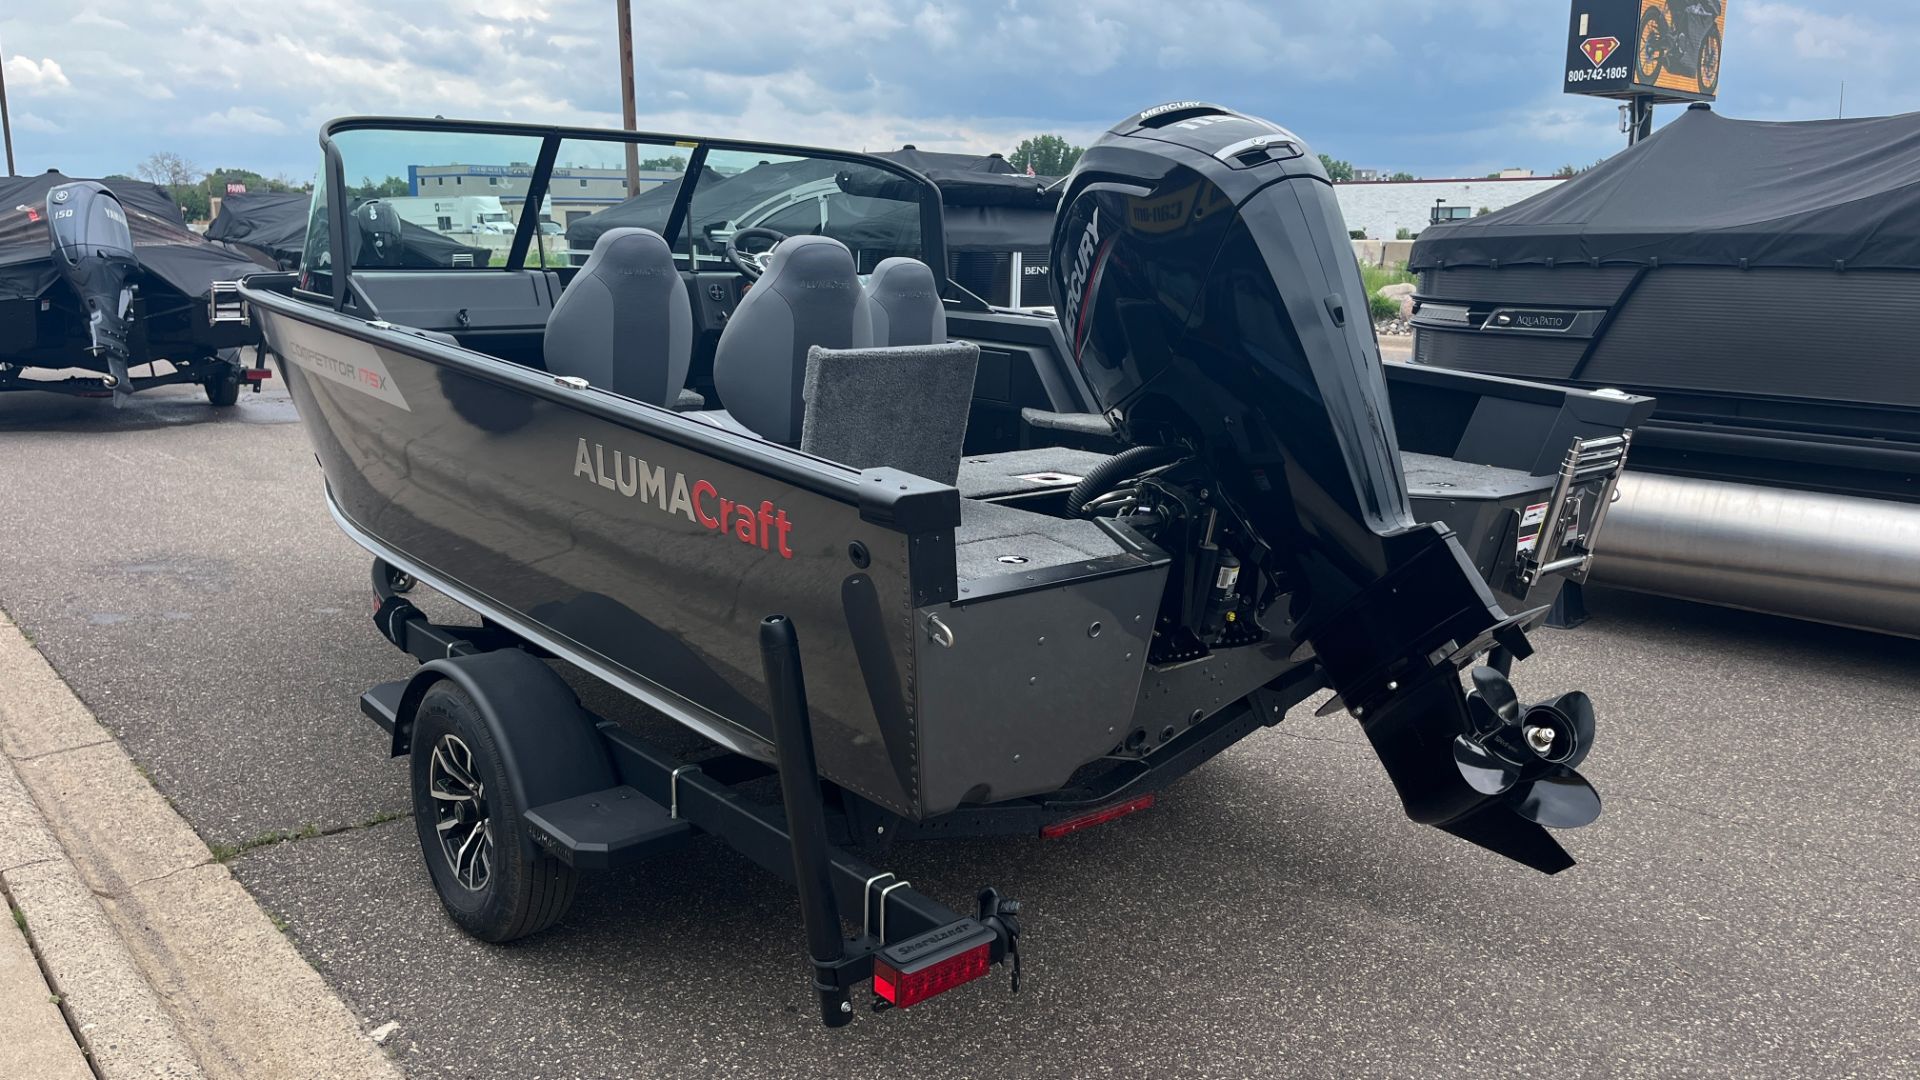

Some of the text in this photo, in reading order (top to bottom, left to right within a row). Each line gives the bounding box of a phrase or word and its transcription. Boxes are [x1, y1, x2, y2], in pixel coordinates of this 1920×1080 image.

[1568, 67, 1627, 82] 800-742-1805
[1140, 101, 1200, 119] MERCURY
[227, 183, 246, 193] PAWN
[55, 209, 74, 220] 150
[289, 342, 356, 380] COMPETITOR
